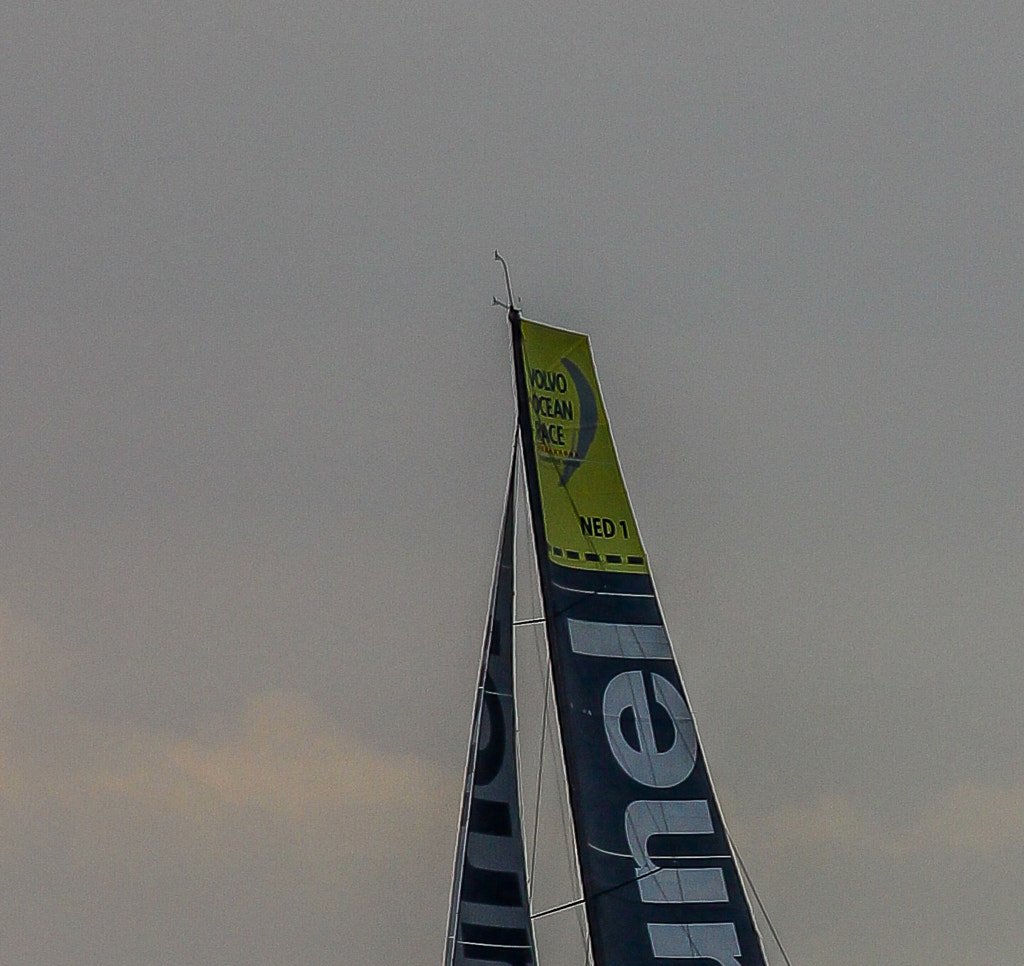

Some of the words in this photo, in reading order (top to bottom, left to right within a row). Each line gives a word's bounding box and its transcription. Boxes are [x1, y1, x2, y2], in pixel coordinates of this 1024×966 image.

[531, 368, 567, 393] VOLVO
[532, 394, 573, 420] OCEAN
[580, 516, 615, 538] NED
[619, 521, 628, 539] 1
